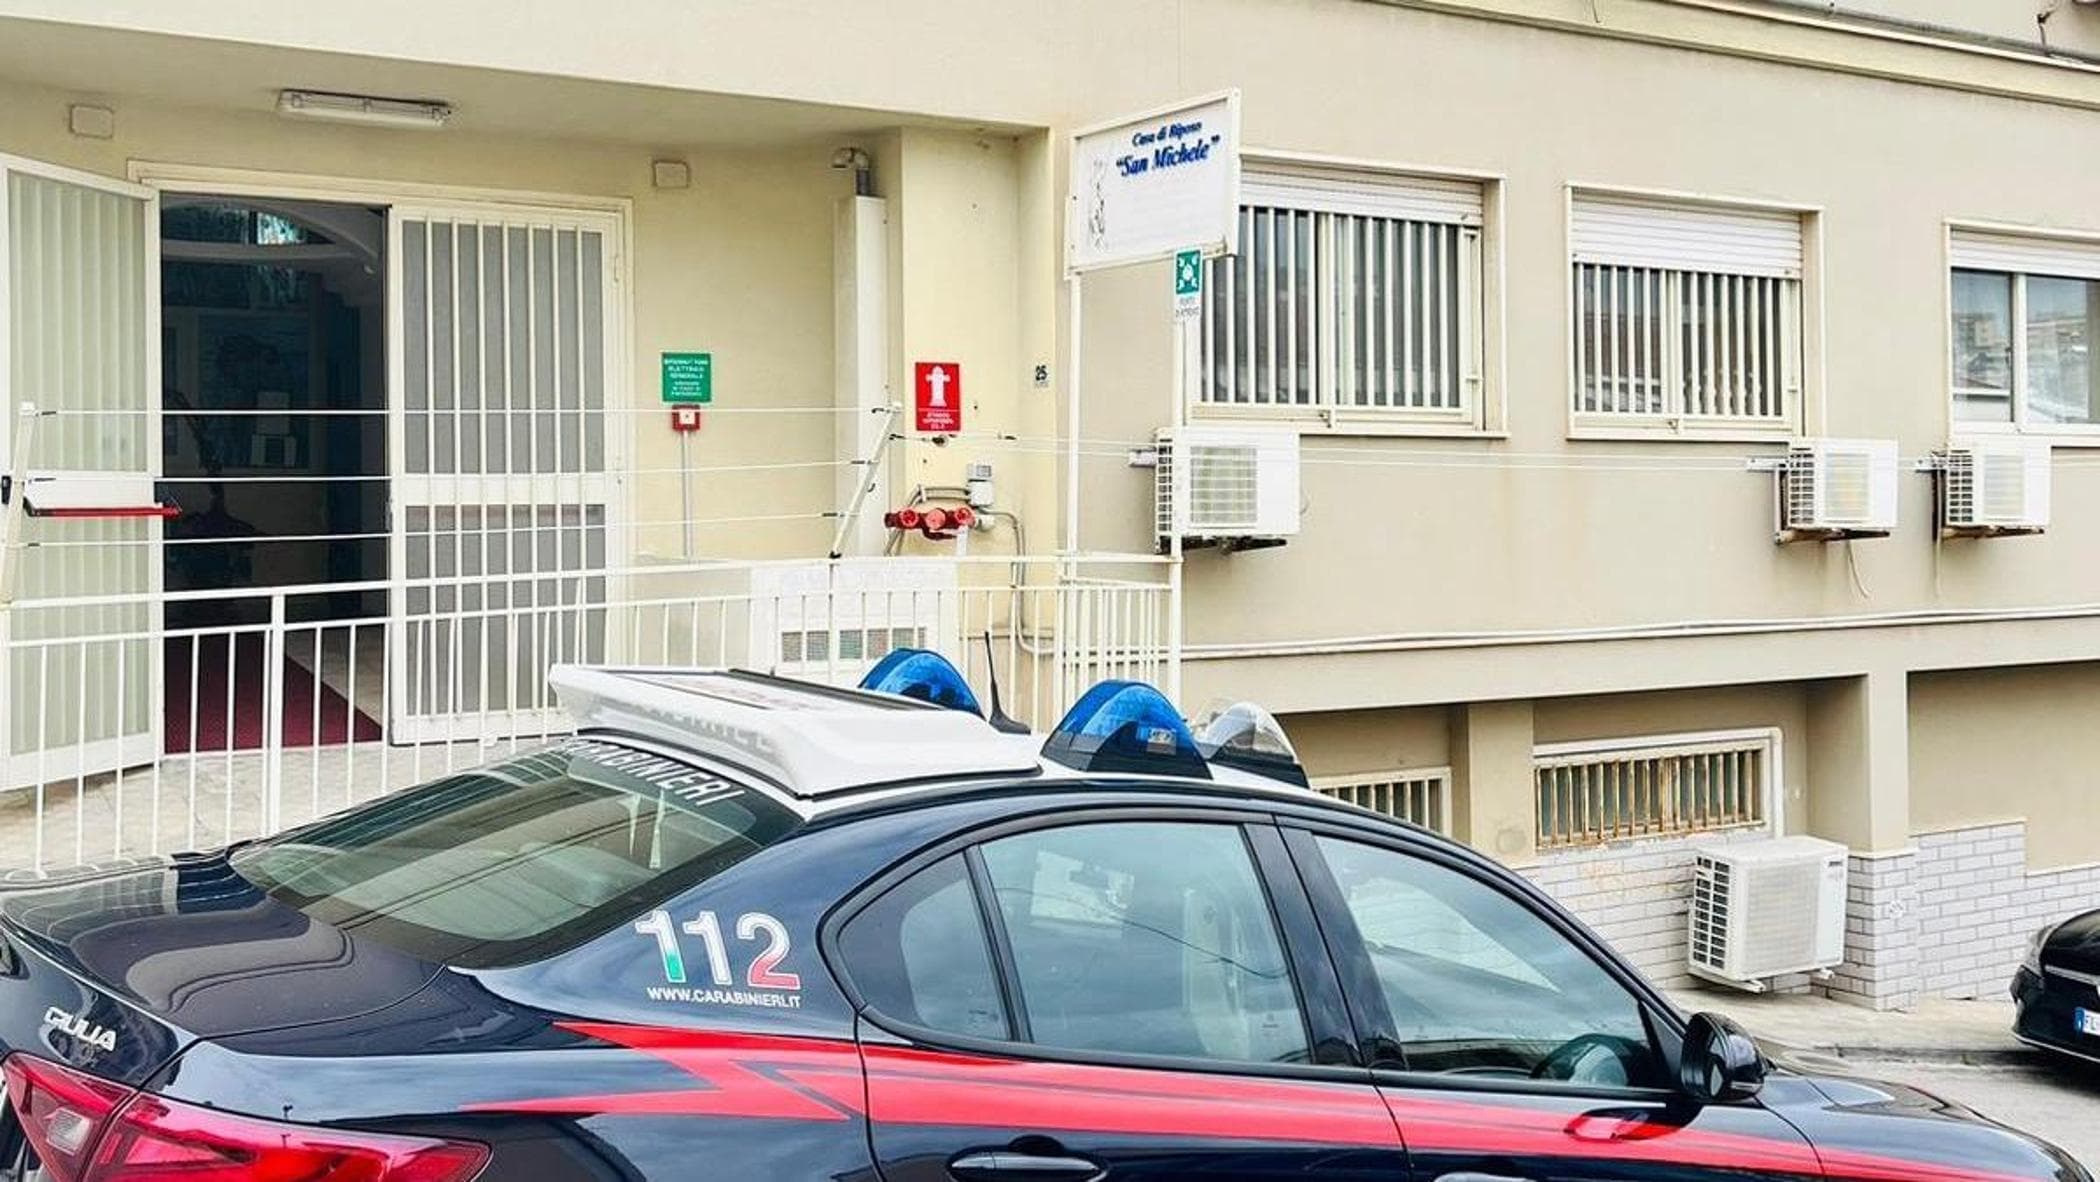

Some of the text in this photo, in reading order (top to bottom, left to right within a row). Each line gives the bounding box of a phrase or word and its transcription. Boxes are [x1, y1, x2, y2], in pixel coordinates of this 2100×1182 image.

[1132, 122, 1202, 147] Casa di Riposo
[1035, 365, 1048, 381] 25
[635, 909, 801, 990] 112
[647, 987, 801, 1009] WWW.CARABINIERI.IT
[44, 1006, 117, 1052] GIULIA
